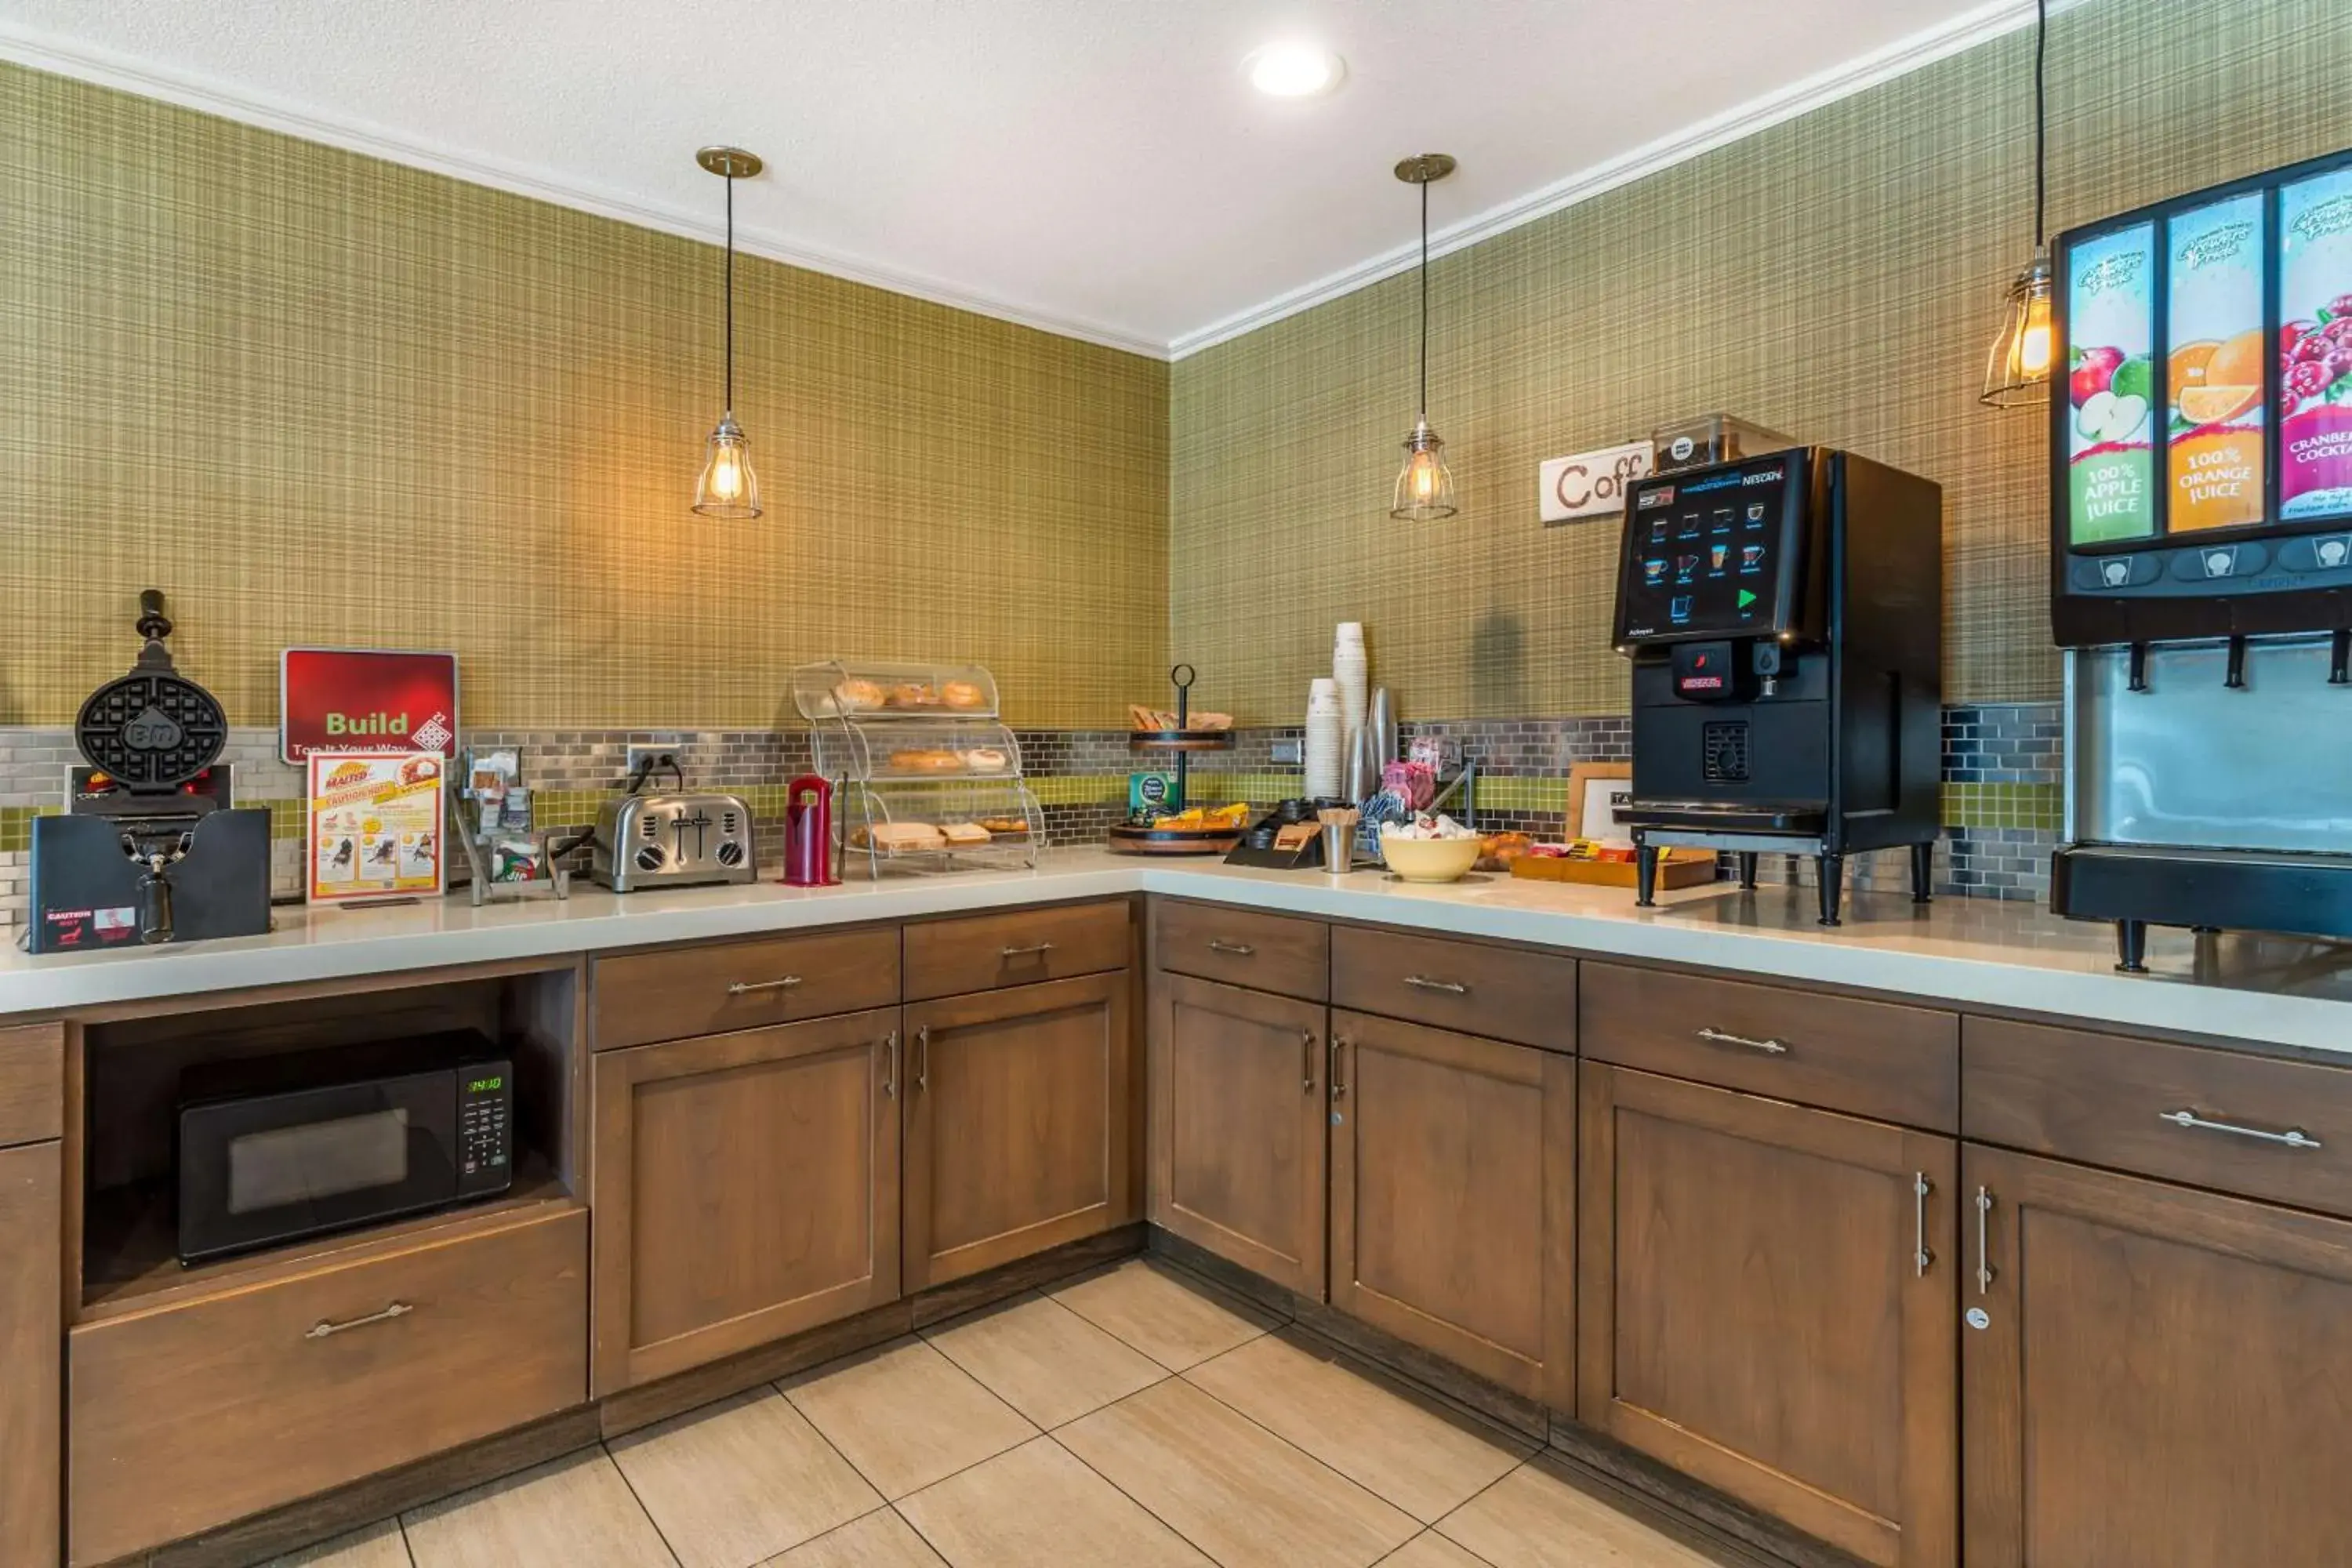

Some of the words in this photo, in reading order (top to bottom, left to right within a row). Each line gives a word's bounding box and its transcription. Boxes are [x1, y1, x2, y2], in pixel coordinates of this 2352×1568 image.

[2188, 448, 2241, 469] 100%
[2089, 463, 2135, 484] 100%
[2180, 466, 2252, 488] ORANGE
[2085, 479, 2142, 501] APPLE
[2190, 483, 2241, 505] JUICE
[2087, 498, 2139, 522] JUICE
[326, 712, 408, 735] Build
[48, 910, 92, 920] CAUTION
